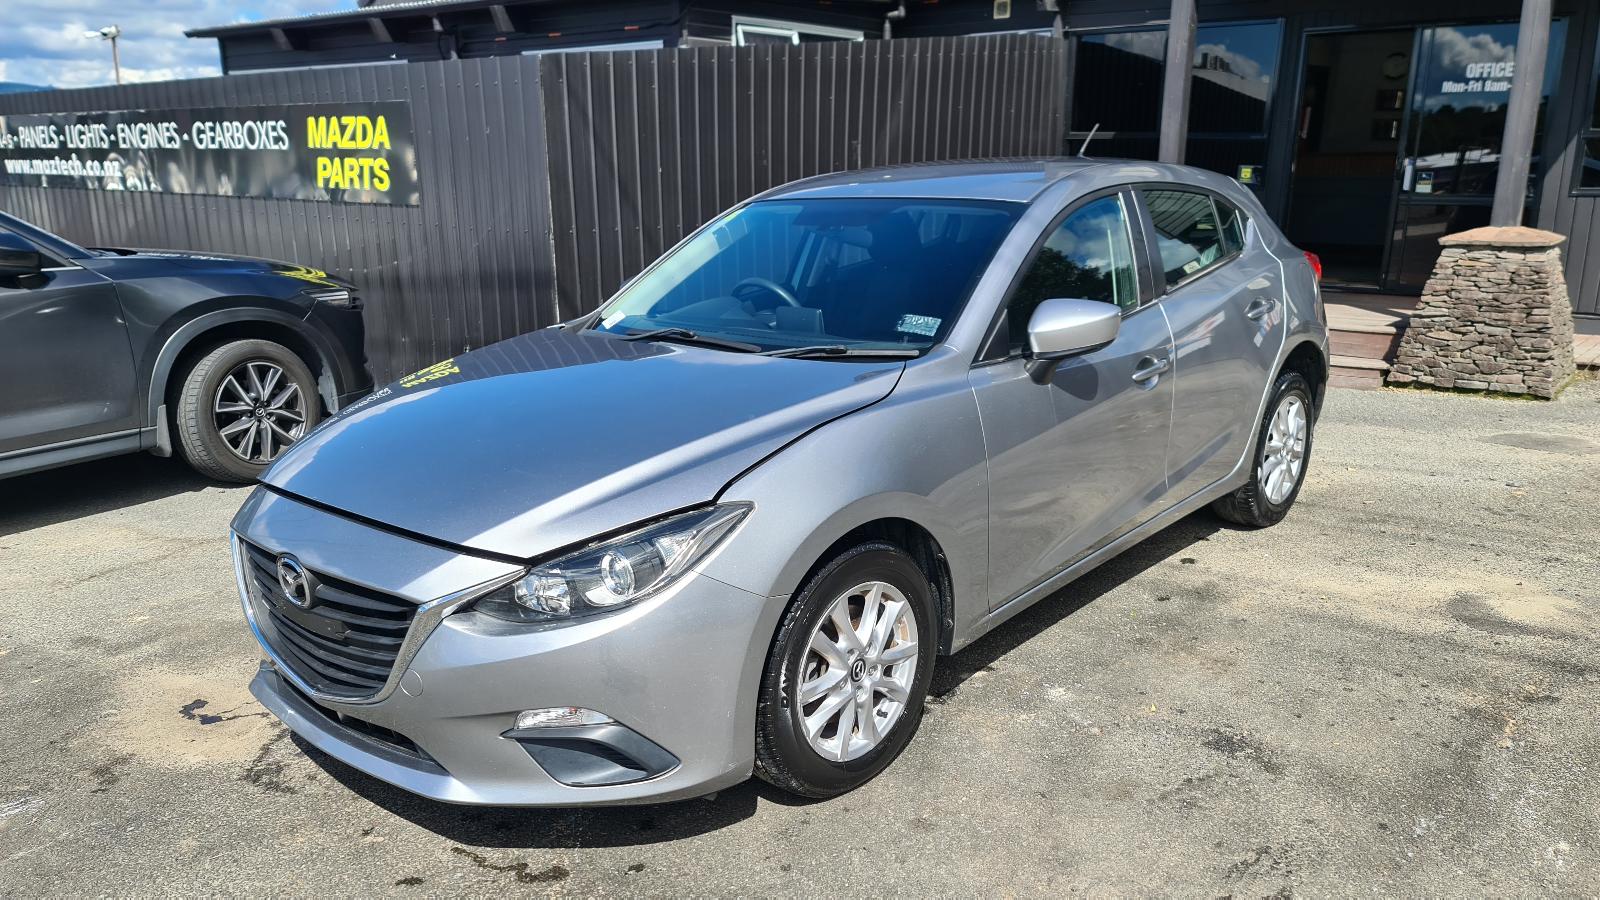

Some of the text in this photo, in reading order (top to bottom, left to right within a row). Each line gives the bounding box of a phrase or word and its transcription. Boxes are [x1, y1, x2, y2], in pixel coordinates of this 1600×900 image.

[1466, 62, 1514, 78] OFFICE
[1441, 81, 1483, 93] Mon-Fri
[18, 124, 58, 149] PANELS
[65, 123, 109, 149] LIGHTS
[117, 121, 180, 149] ENGINES
[192, 120, 290, 150] GEARBOXES
[307, 115, 391, 150] MAZDA
[4, 153, 122, 176] www.maztech.co.nz
[316, 156, 391, 191] PARTS
